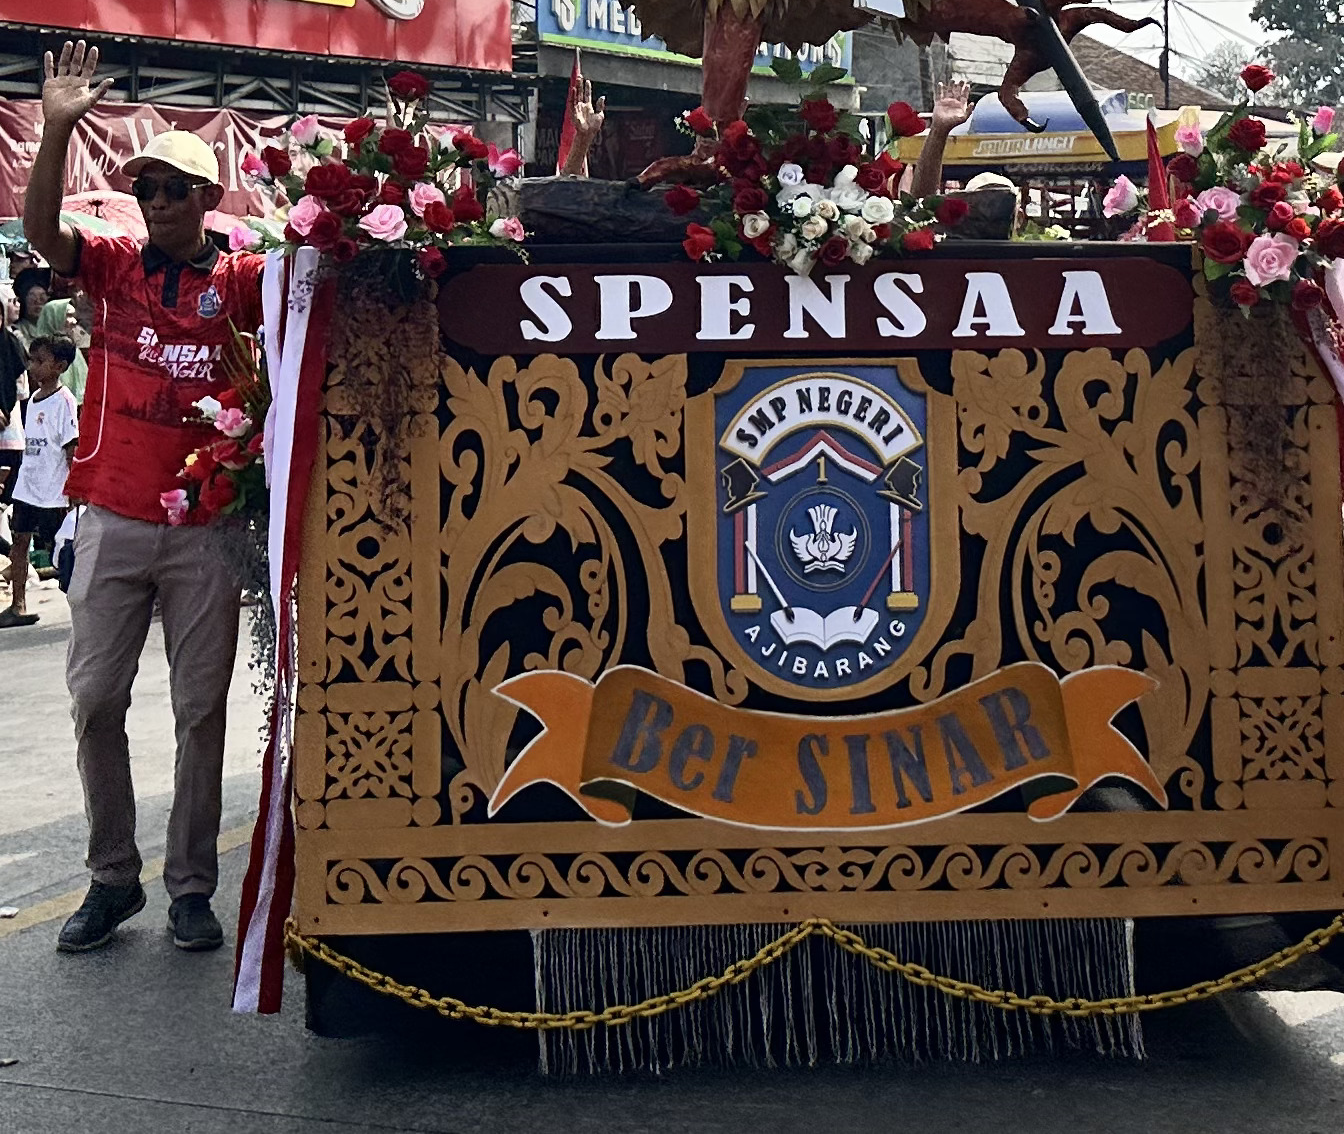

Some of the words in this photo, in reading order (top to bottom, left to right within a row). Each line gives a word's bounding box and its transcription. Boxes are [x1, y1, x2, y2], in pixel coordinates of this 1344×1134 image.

[520, 270, 1122, 341] SPENSAA
[736, 396, 787, 448] SMP
[796, 386, 904, 446] NEGERI
[816, 456, 828, 484] 1
[744, 619, 906, 679] AJIBARANG
[608, 687, 757, 804] Ber
[795, 685, 1052, 816] SINAR
